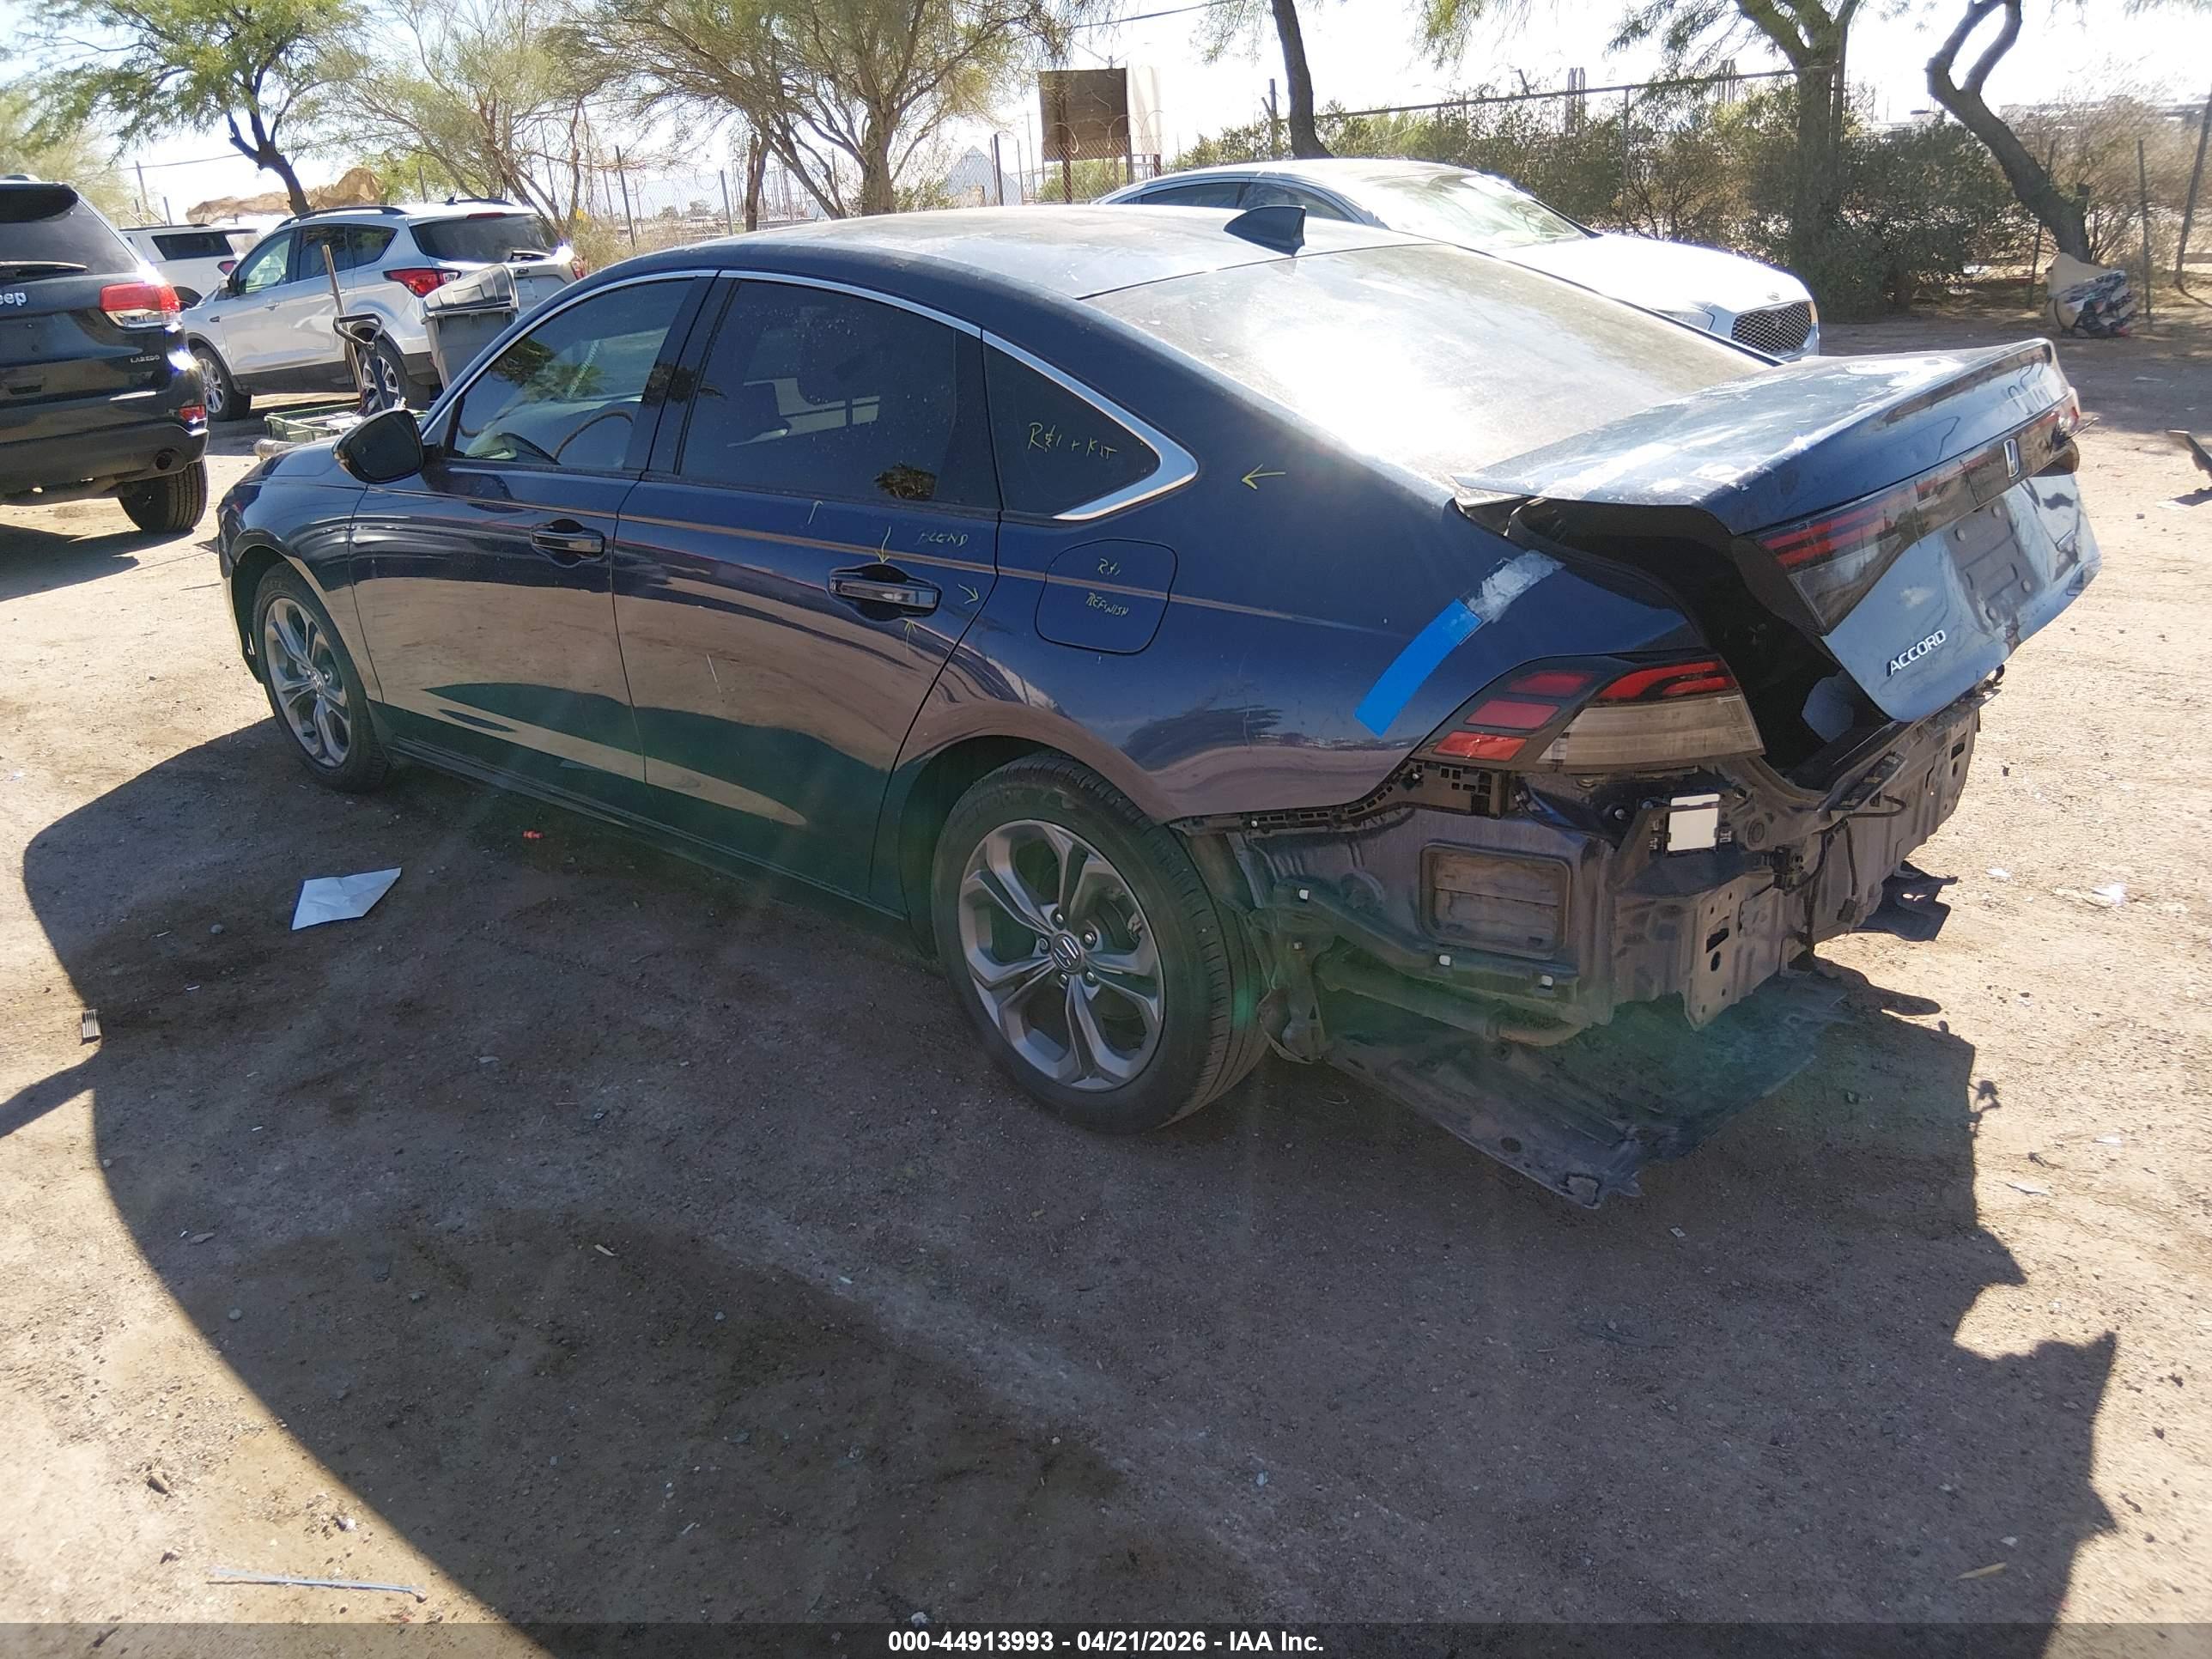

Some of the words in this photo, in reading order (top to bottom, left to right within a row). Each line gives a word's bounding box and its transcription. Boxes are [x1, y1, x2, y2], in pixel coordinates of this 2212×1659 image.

[130, 354, 161, 363] LAREDO
[1085, 437, 1118, 460] KIT
[1887, 629, 1947, 676] ACCORD
